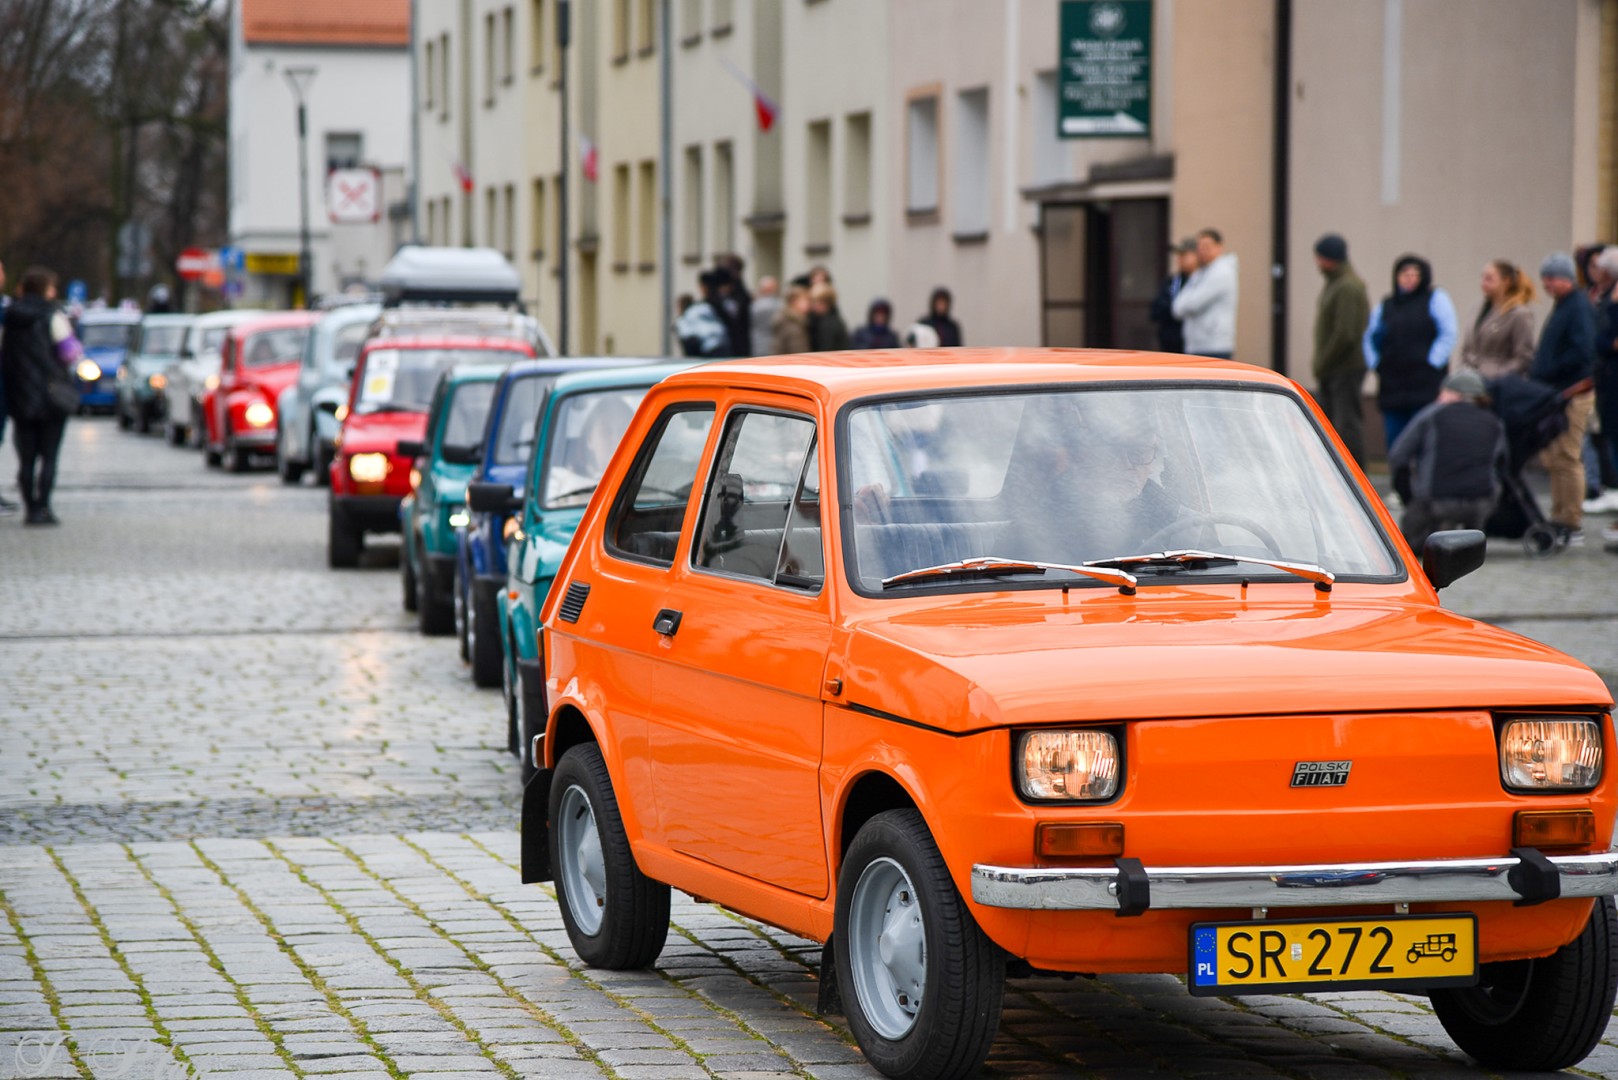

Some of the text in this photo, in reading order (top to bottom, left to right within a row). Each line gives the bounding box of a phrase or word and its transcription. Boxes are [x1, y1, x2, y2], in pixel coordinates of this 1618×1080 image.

[1298, 762, 1350, 772] POLSKI
[1295, 772, 1346, 785] FIAT
[1227, 926, 1394, 978] SR 272
[1198, 963, 1215, 976] PL
